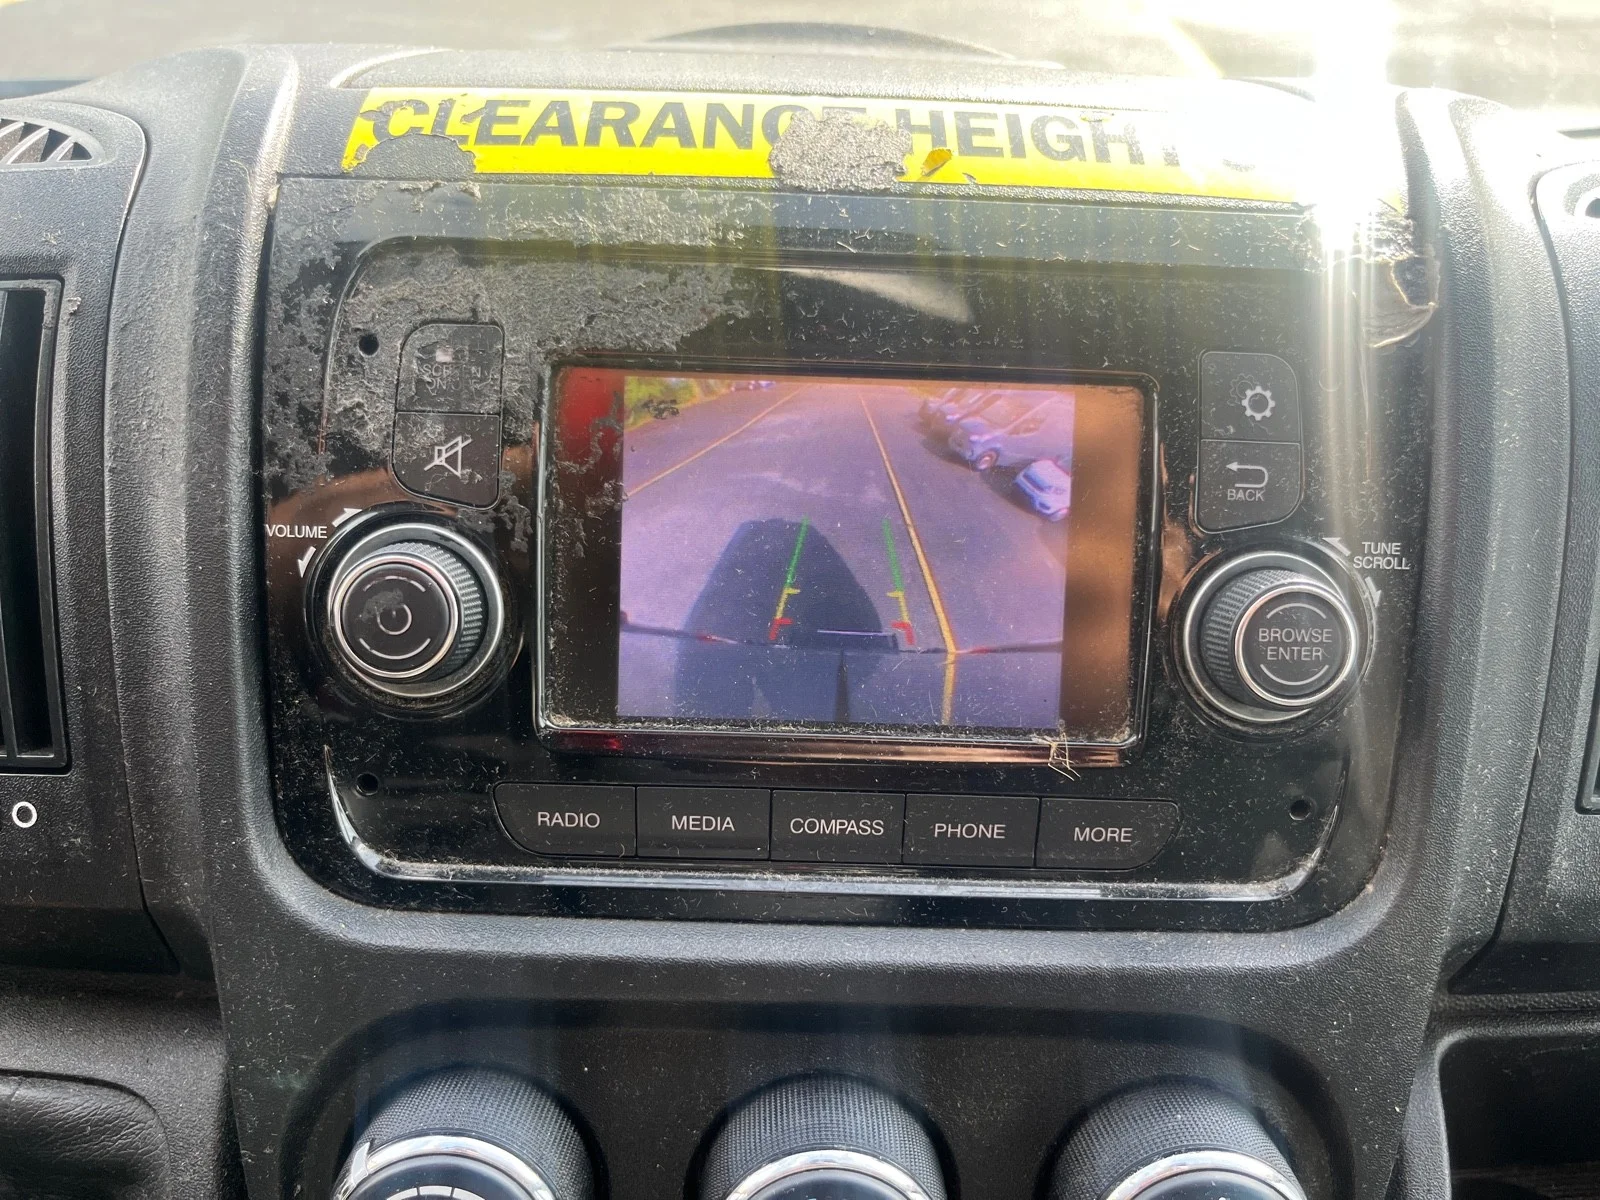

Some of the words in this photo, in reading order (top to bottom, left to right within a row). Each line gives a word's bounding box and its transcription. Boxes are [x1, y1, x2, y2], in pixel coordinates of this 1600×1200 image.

[1227, 488, 1266, 502] BACK
[265, 524, 328, 539] VOLUME
[1361, 542, 1401, 555] TUNE
[1353, 557, 1410, 570] SCROLL
[1258, 628, 1332, 642] BROWSE
[1267, 647, 1323, 661] ENTER
[536, 811, 601, 828] RADIO
[671, 815, 736, 832] MEDIA
[789, 818, 885, 836] COMPASS
[934, 823, 1006, 840] PHONE
[1074, 827, 1133, 843] MORE
